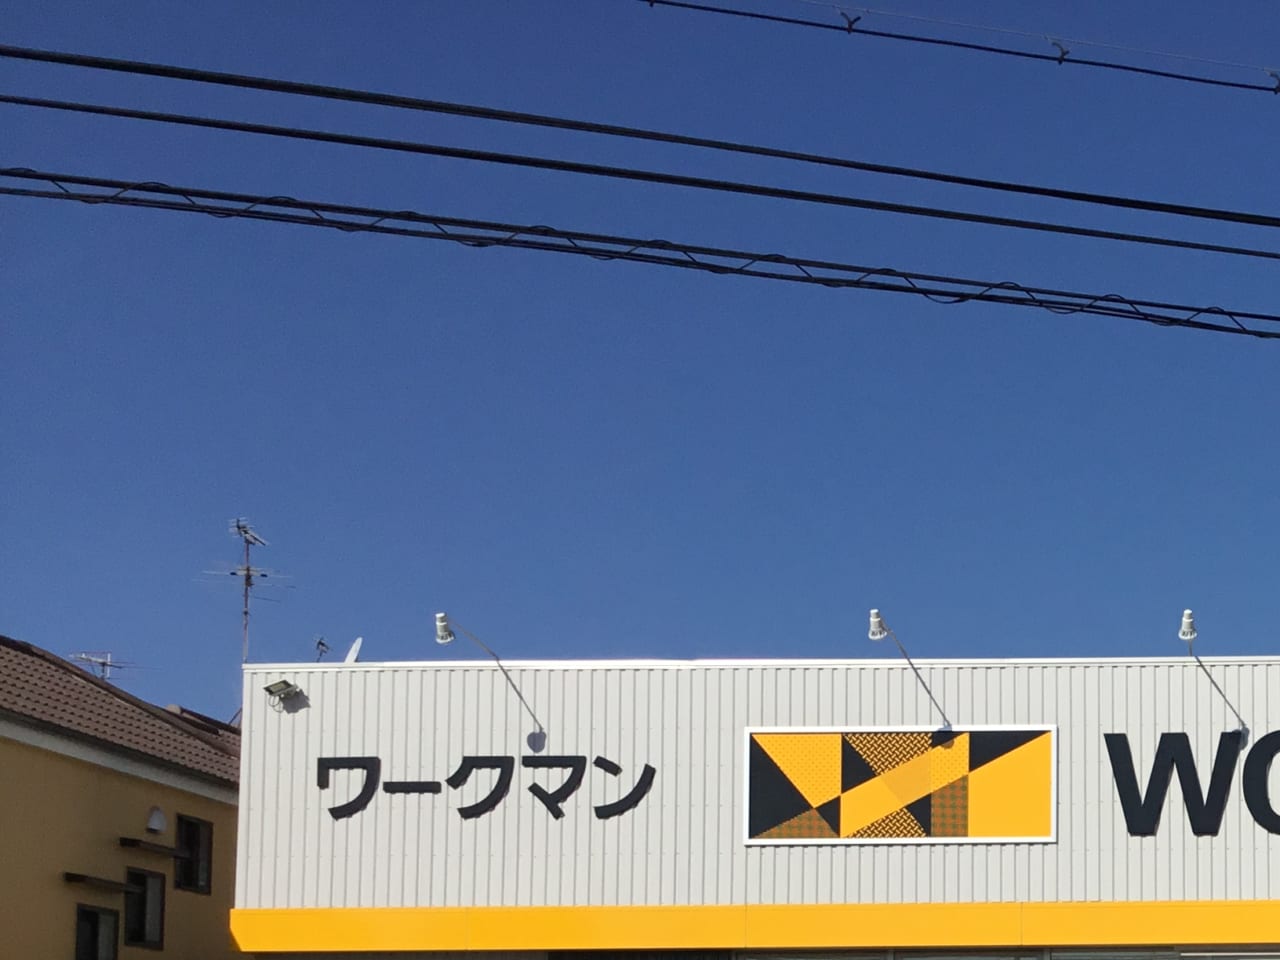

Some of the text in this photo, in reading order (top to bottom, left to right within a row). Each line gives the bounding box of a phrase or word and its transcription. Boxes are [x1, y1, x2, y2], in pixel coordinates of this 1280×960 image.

[317, 755, 656, 821] ワークマン
